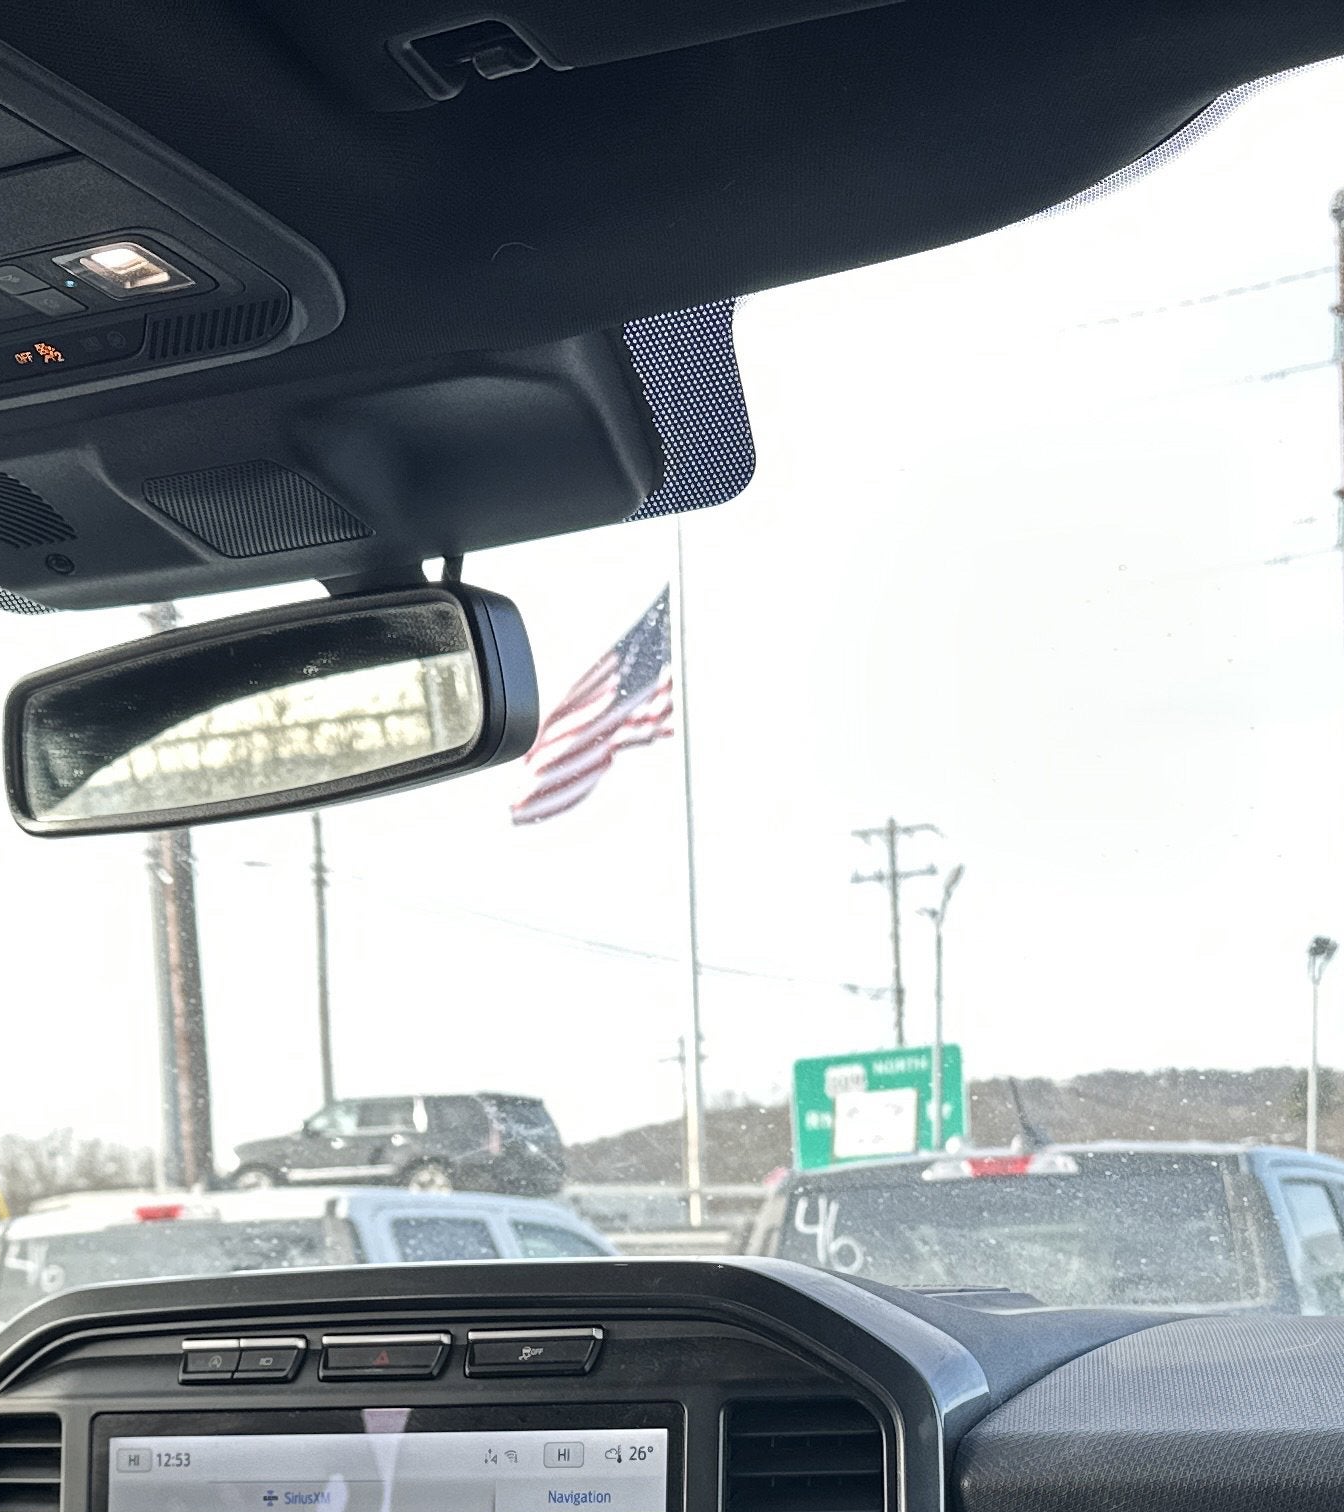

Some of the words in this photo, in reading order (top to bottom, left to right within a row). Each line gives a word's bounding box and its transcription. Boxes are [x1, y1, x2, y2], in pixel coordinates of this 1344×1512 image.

[156, 1453, 191, 1467] 12:53
[557, 1448, 570, 1461] HI
[629, 1446, 654, 1461] 26°
[128, 1455, 140, 1467] HI
[284, 1492, 330, 1505] SiriusXM
[547, 1490, 611, 1506] Navigation
